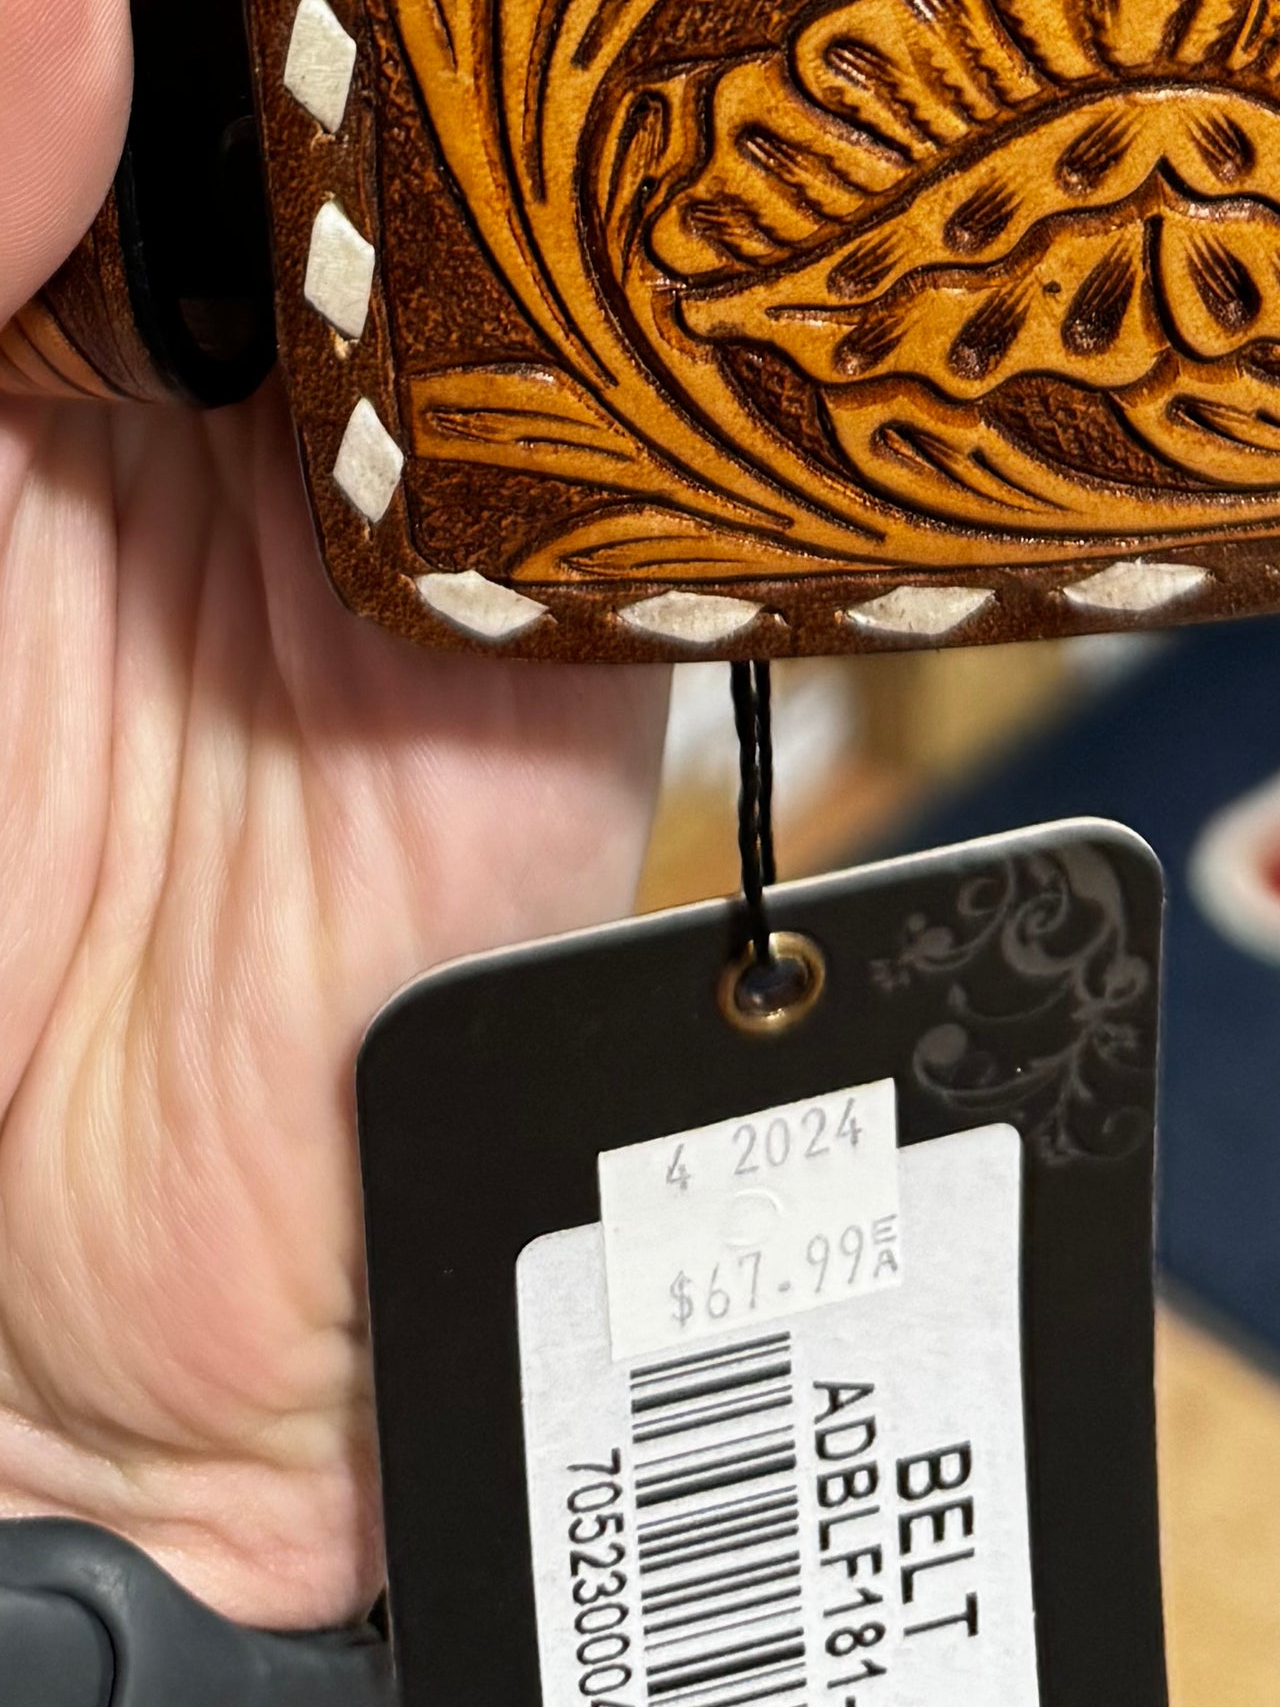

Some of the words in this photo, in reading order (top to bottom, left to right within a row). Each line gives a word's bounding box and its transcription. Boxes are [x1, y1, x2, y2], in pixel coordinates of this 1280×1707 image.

[665, 1143, 692, 1191] 4
[732, 1097, 863, 1176] 2024
[669, 1224, 864, 1328] $67.99
[566, 1446, 635, 1707] 70523000
[896, 1439, 979, 1638] BELT
